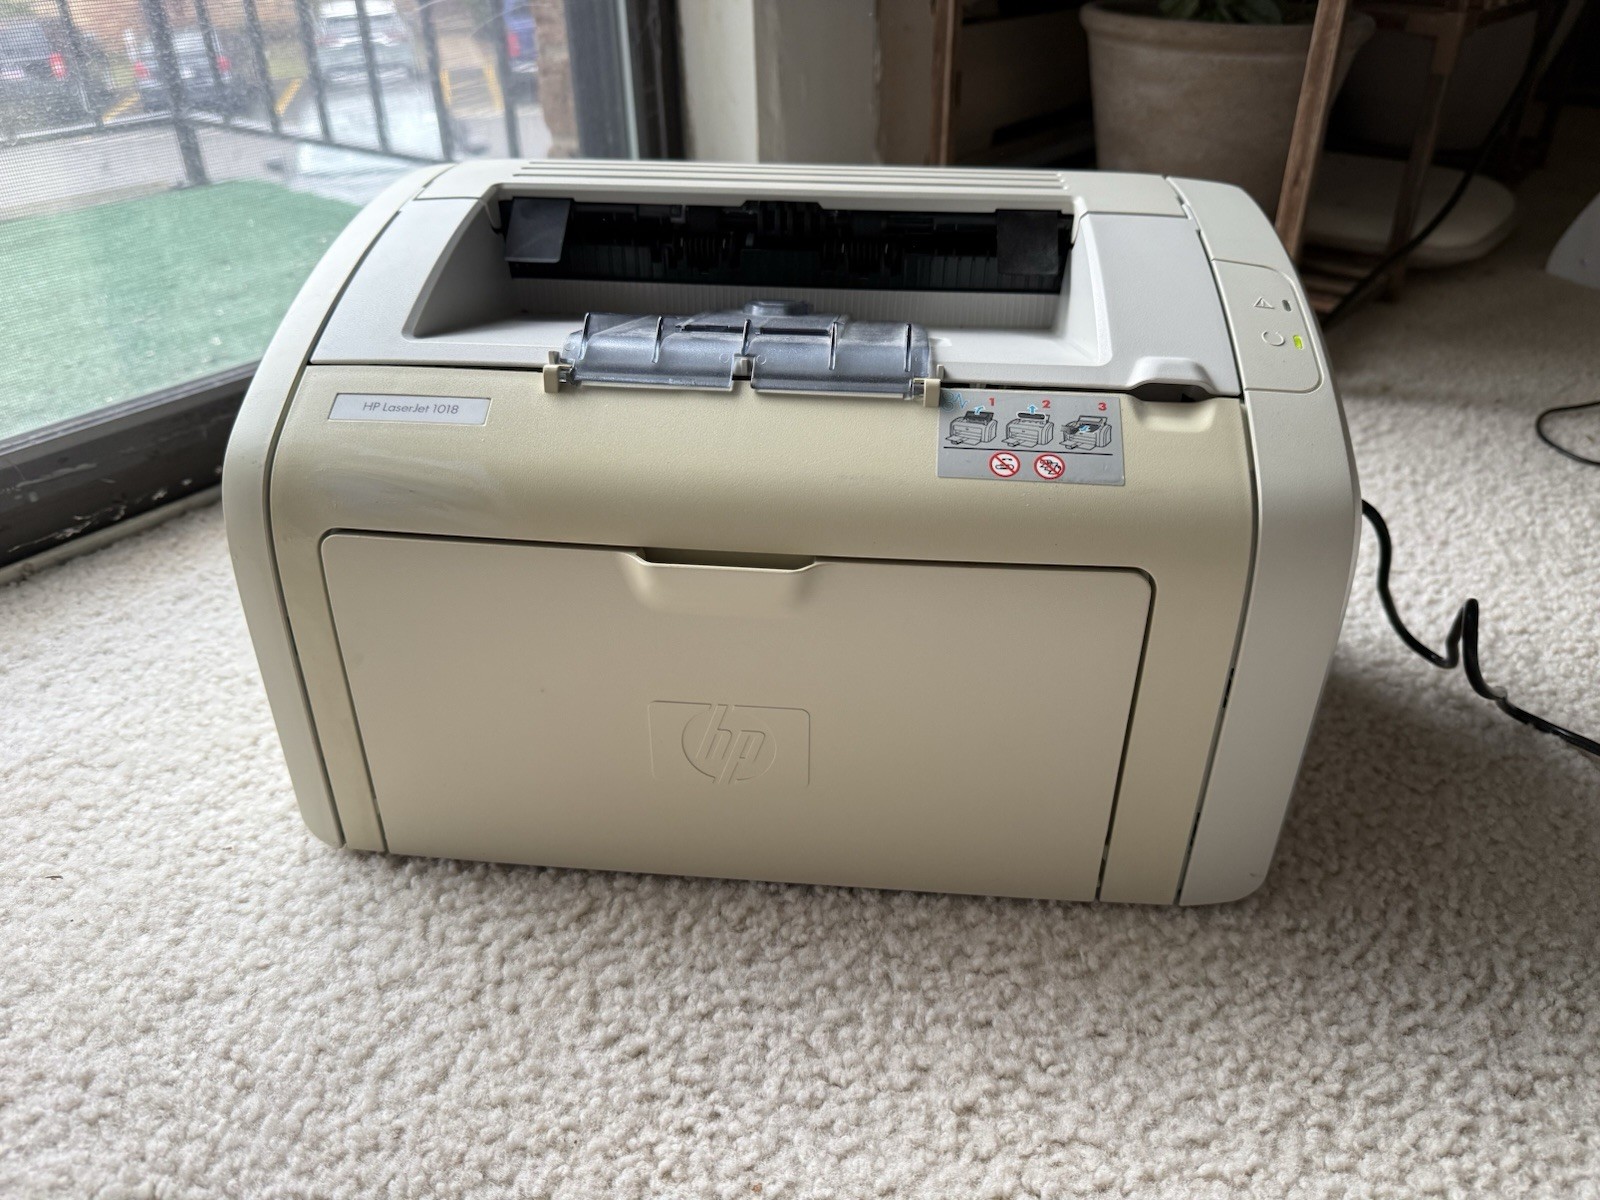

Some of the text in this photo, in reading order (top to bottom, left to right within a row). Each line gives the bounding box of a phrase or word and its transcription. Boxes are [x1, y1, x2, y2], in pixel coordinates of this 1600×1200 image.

[989, 397, 995, 406] 1
[1042, 400, 1051, 409] 2
[363, 402, 459, 414] HP LaserJet 1018
[1098, 402, 1107, 411] 3
[695, 704, 766, 784] hp
